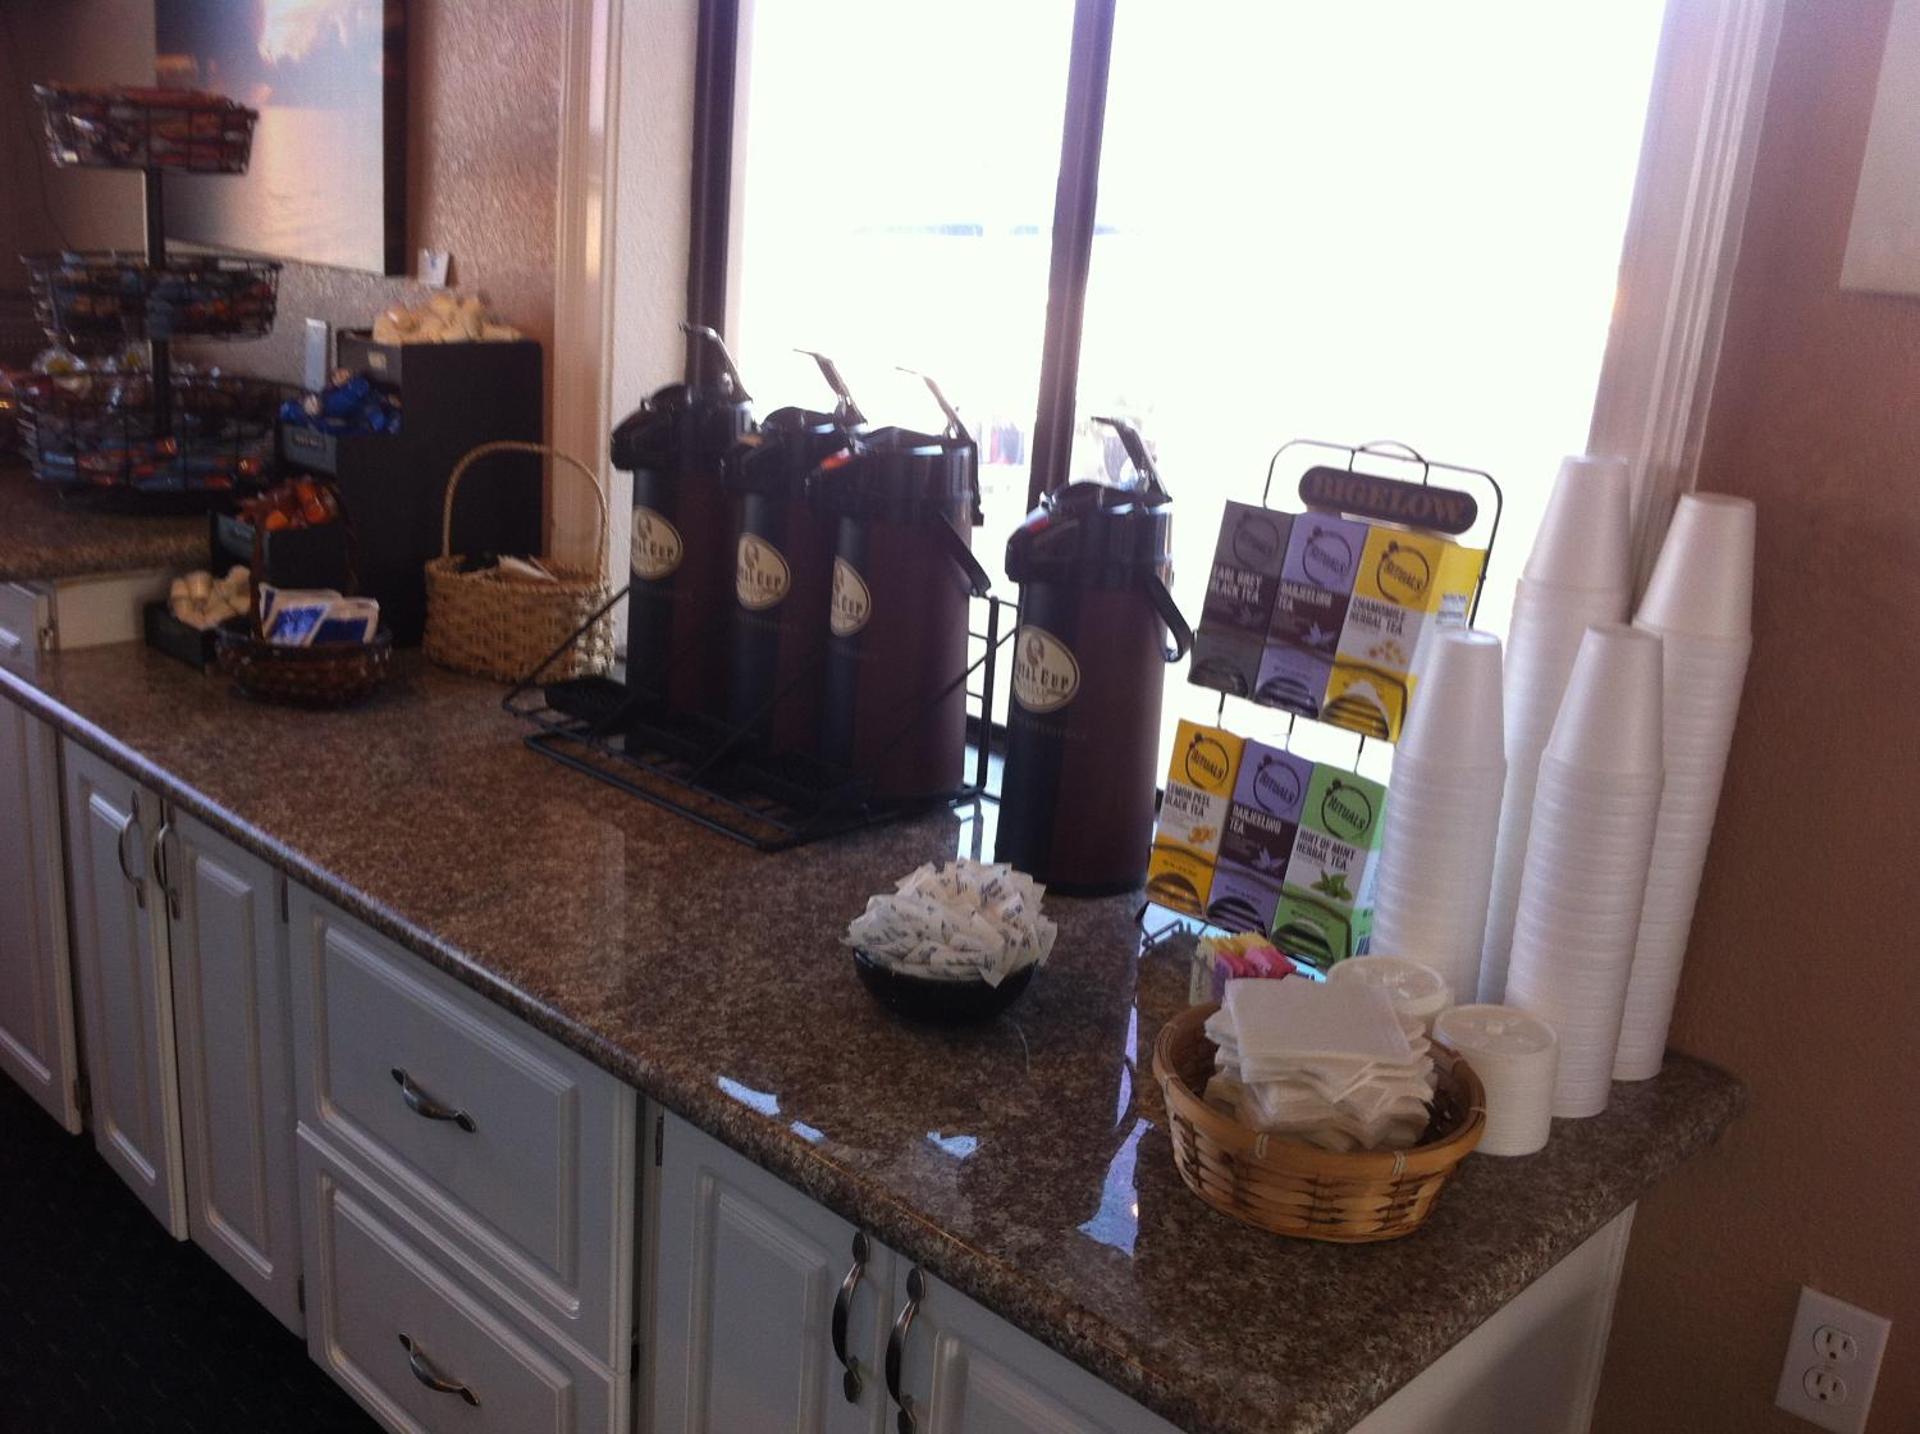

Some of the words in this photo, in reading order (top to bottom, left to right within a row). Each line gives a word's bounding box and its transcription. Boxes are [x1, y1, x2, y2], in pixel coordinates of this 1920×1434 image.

[1312, 474, 1466, 523] BIGELOW
[1242, 583, 1260, 606] TEA
[1278, 596, 1294, 612] TEA
[1385, 618, 1403, 636] TEA
[1190, 749, 1223, 780] RITUALS
[1168, 782, 1193, 801] LEMON
[1192, 790, 1211, 808] PEEL
[1259, 769, 1295, 803] RITUALS
[1165, 793, 1188, 812] BLACK
[1190, 802, 1205, 818] TEA
[1327, 794, 1366, 831] RITUALS
[1229, 816, 1245, 835] TEA
[1232, 804, 1282, 834] DARJEELING
[1296, 840, 1327, 864] HERBAL
[1330, 855, 1347, 872] TEA
[1319, 837, 1331, 849] OF
[1331, 842, 1355, 862] MINT
